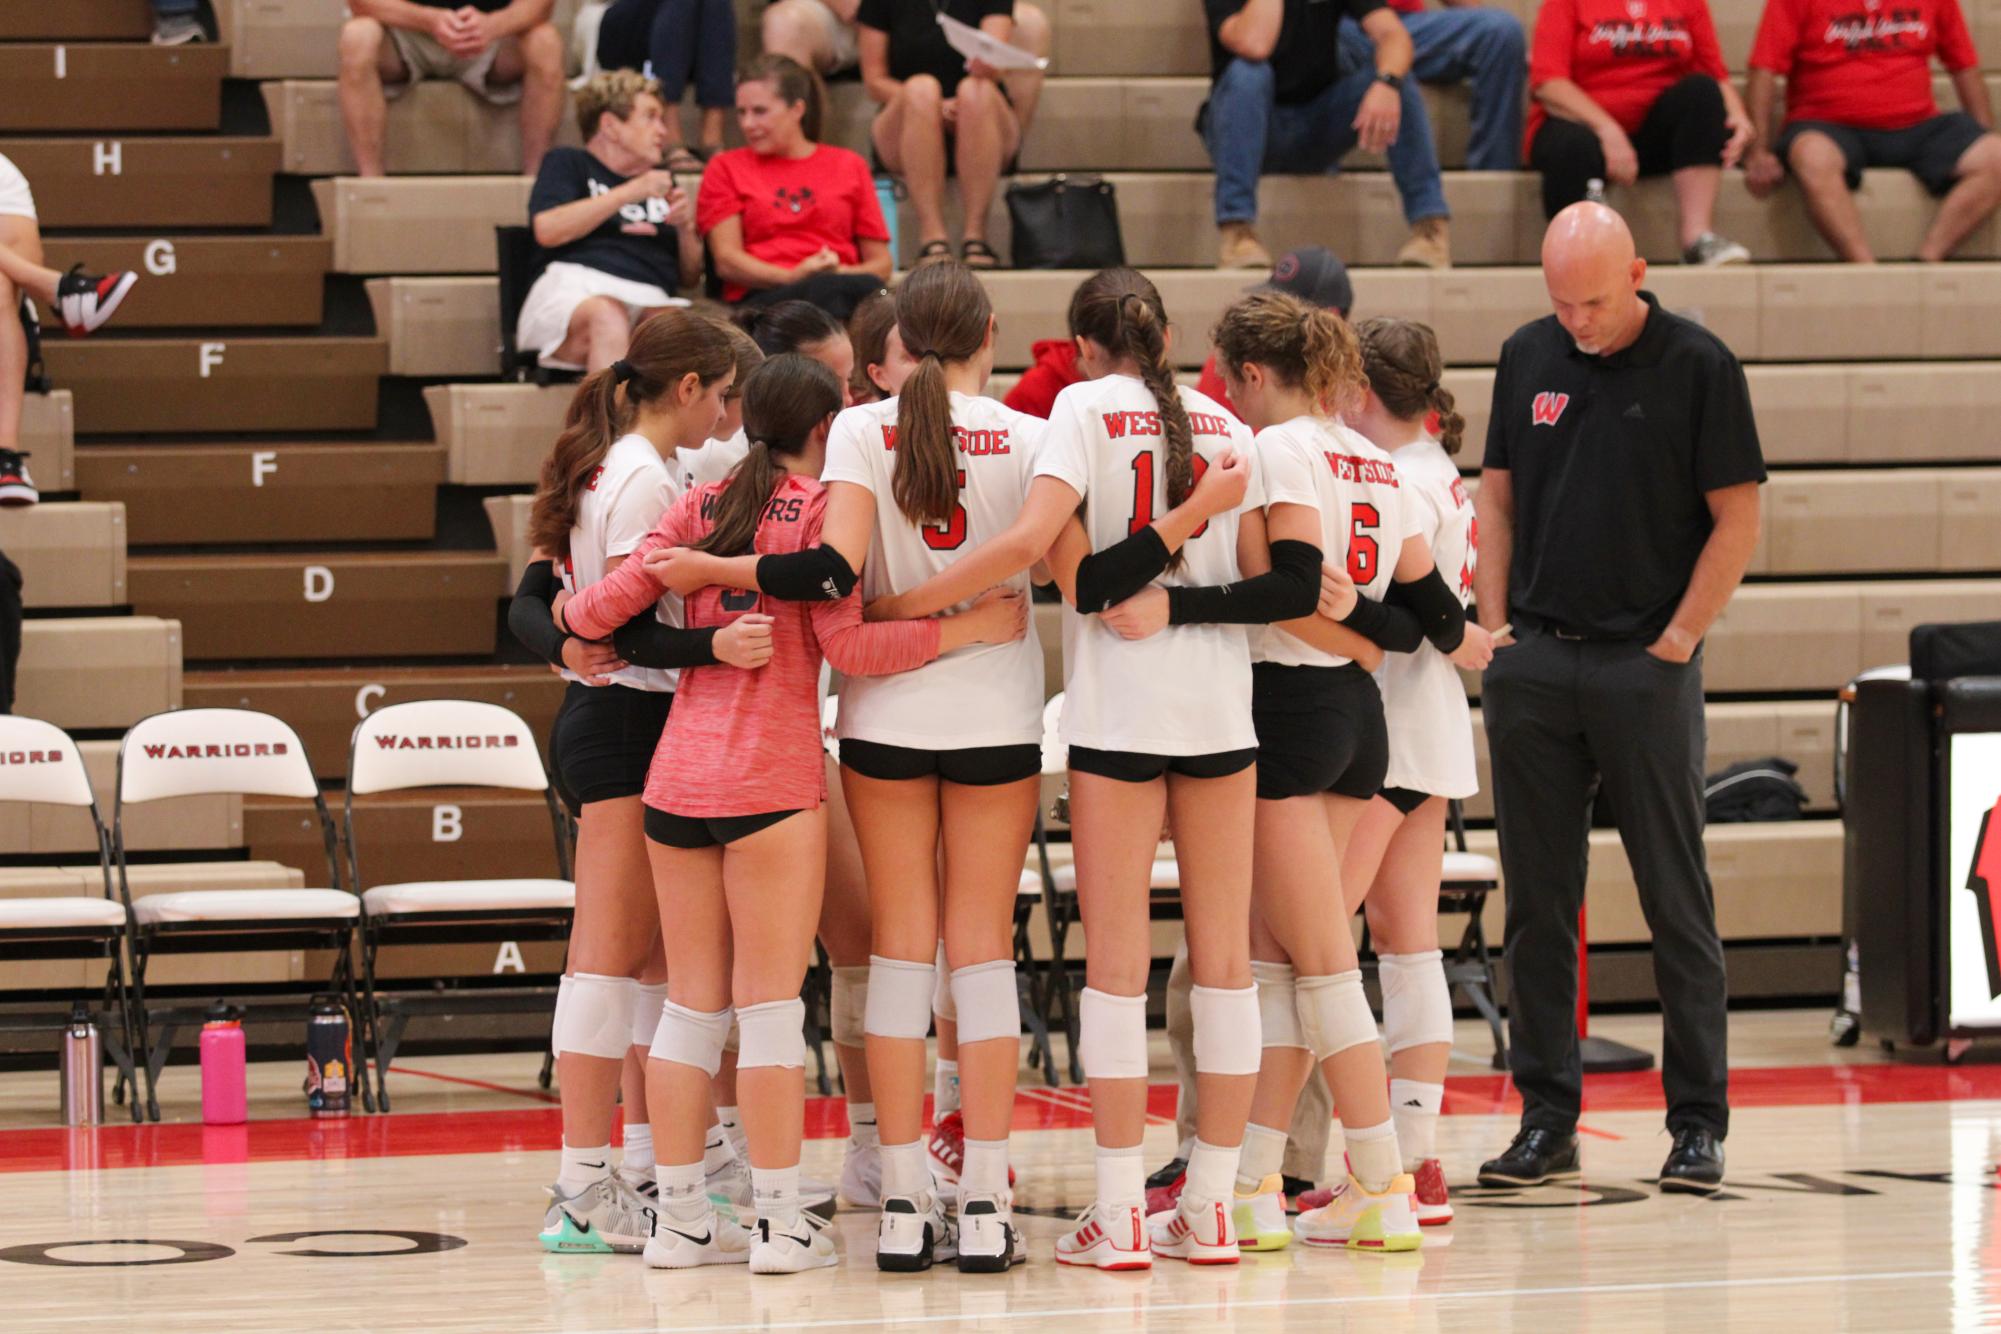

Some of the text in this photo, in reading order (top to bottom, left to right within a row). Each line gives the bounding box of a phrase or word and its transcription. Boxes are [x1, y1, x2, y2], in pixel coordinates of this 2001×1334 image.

[94, 141, 122, 175] H
[144, 239, 176, 275] G
[200, 342, 225, 377] F
[1103, 411, 1231, 439] WESIDE
[1532, 391, 1570, 426] W
[252, 451, 277, 487] F
[1347, 502, 1380, 586] 6
[304, 566, 334, 602] D
[355, 684, 386, 718] C
[143, 743, 288, 759] WARRIORS
[374, 735, 518, 749] WARRIORS
[432, 804, 463, 842] B
[493, 941, 525, 974] A
